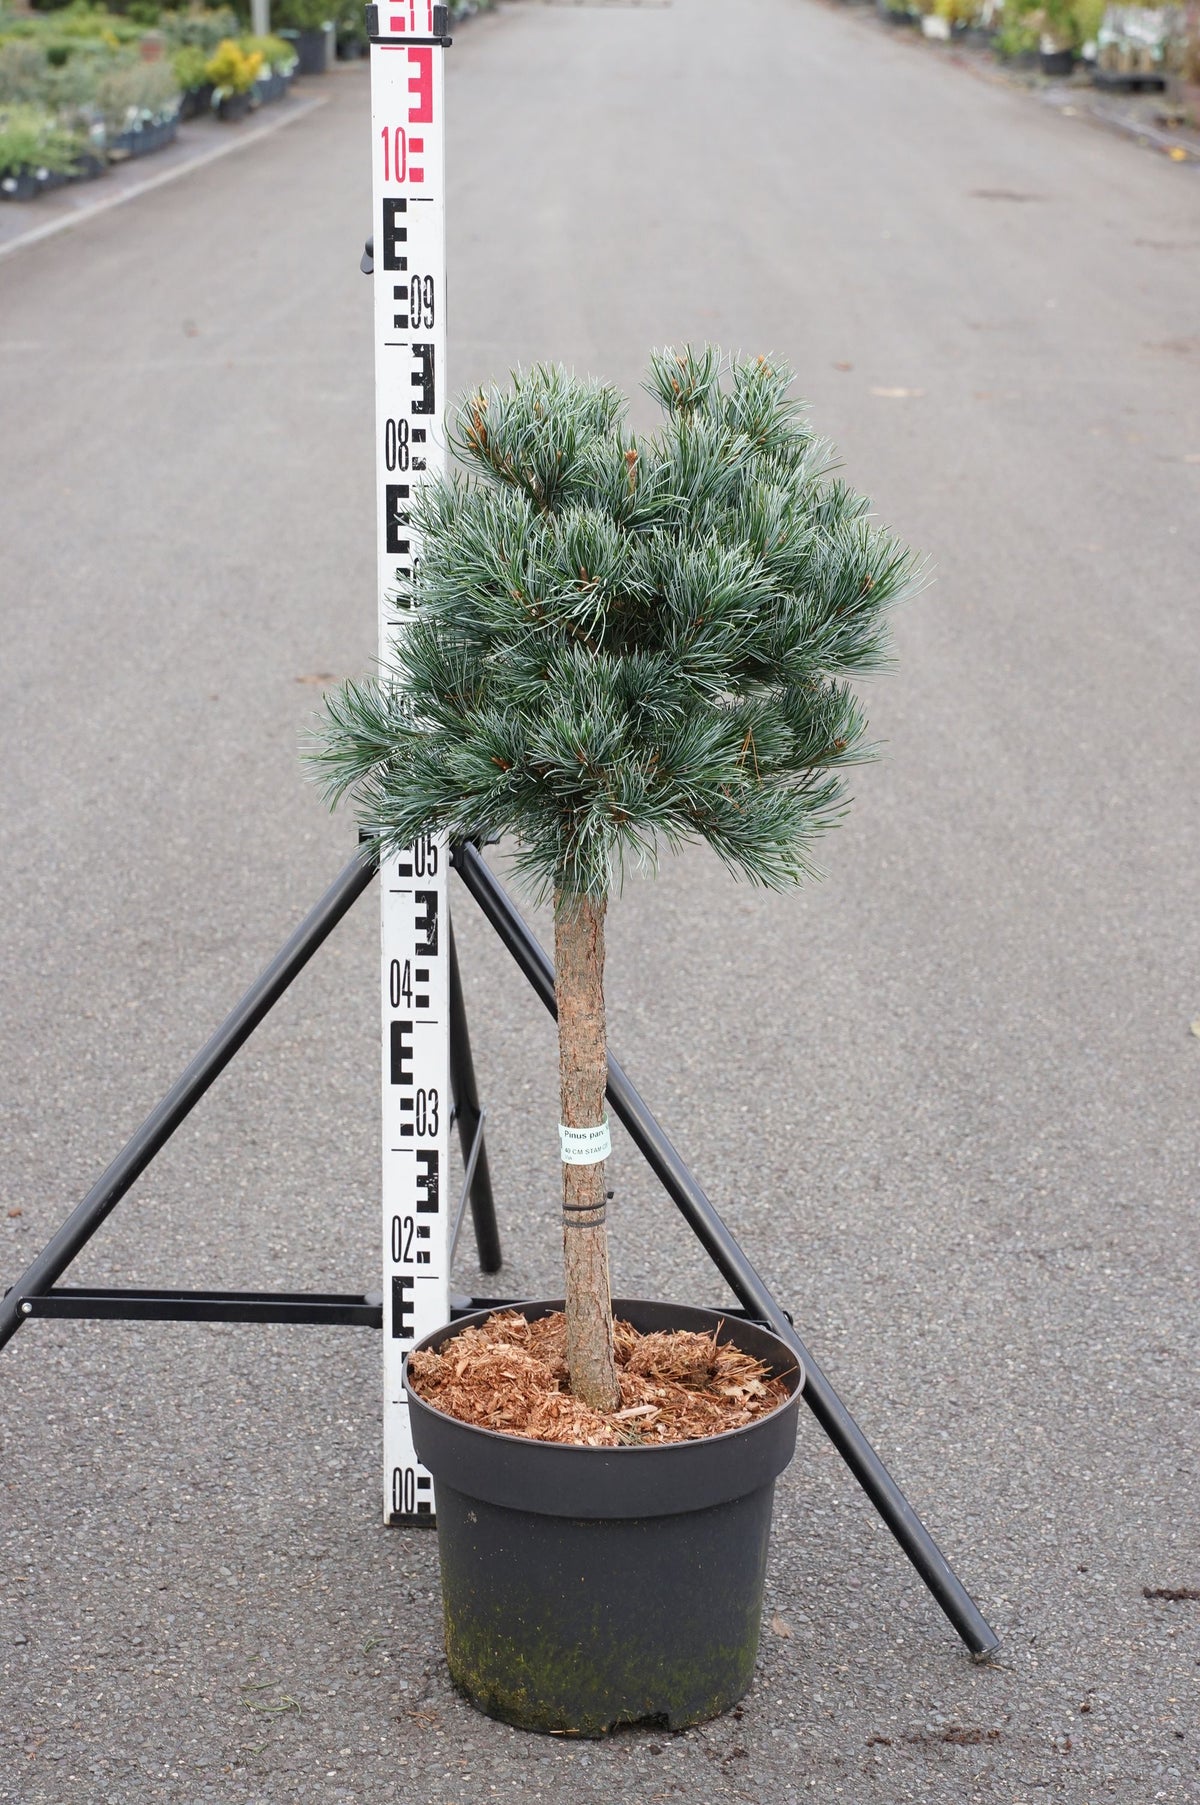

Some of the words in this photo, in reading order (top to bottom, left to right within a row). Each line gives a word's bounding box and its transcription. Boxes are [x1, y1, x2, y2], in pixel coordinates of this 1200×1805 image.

[381, 126, 406, 183] 10
[410, 274, 434, 330] 09
[385, 418, 409, 472] 08
[414, 832, 438, 878] 05
[390, 958, 413, 1009] 04
[416, 1088, 439, 1138] 03
[564, 1129, 587, 1139] Pinus
[391, 1215, 414, 1264] 02
[392, 1466, 415, 1513] 00
